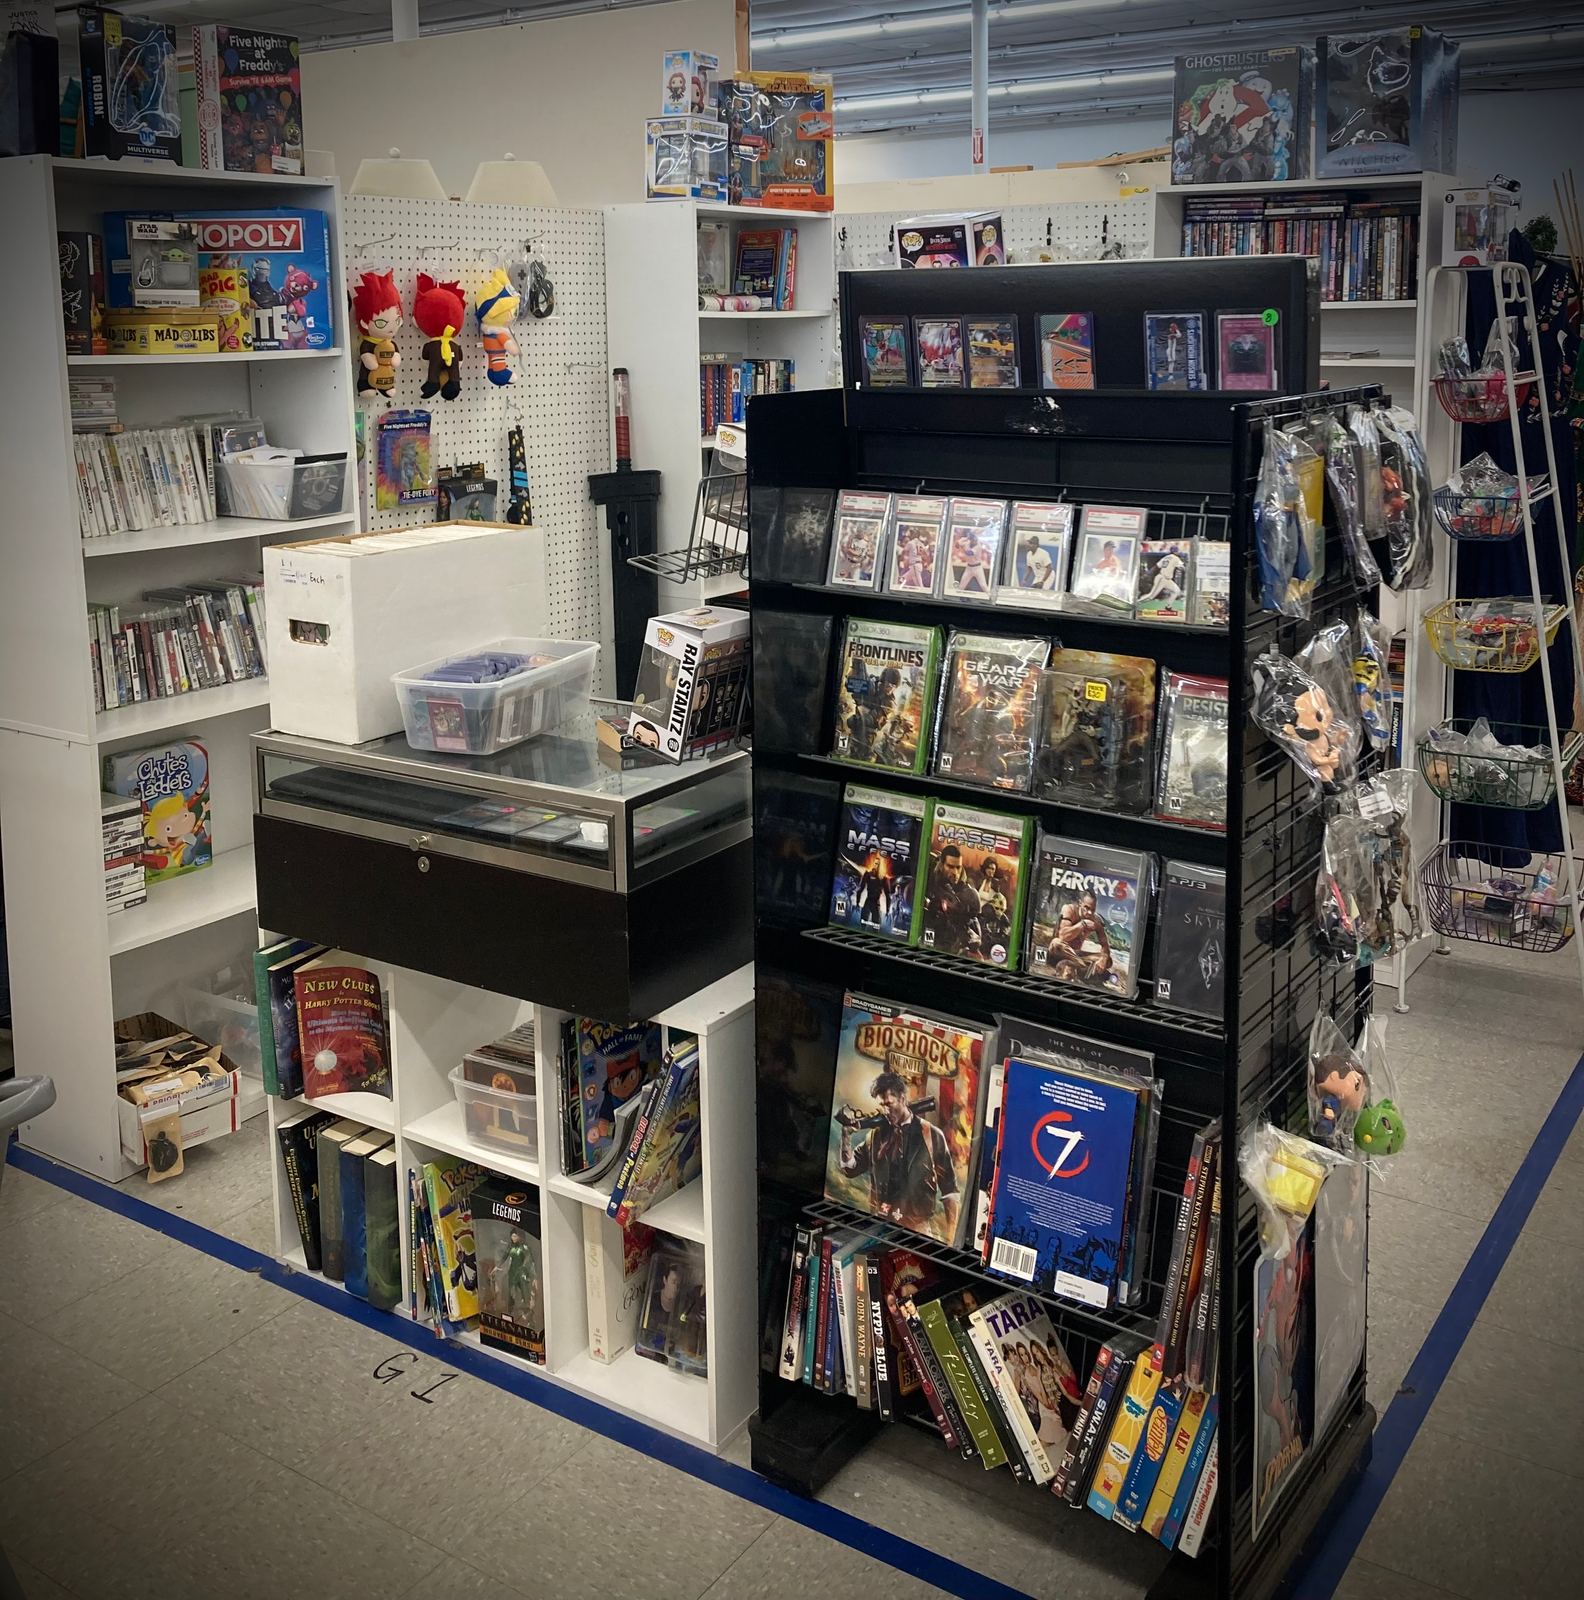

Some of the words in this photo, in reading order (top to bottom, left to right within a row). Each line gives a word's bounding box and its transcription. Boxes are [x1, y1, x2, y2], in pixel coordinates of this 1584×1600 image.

[229, 36, 251, 47] Five
[253, 36, 288, 49] Nights
[254, 49, 266, 59] at
[239, 59, 284, 73] Freddy's
[92, 75, 105, 116] ROBIN
[139, 130, 157, 144] DC
[127, 145, 169, 156] MULTIVERSE
[209, 276, 235, 296] PIG
[154, 328, 180, 341] MAD
[192, 329, 215, 341] LIBS
[82, 478, 93, 514] collection
[466, 483, 484, 492] LEGENDS
[681, 643, 698, 676] RAY
[848, 641, 924, 667] FRONTLINES
[963, 660, 1030, 678] GEARS
[979, 672, 1023, 689] WAR
[669, 677, 692, 737] STANTZ
[138, 752, 188, 781] Chutes
[941, 756, 952, 768] M
[139, 770, 192, 802] Ladders
[1172, 798, 1180, 807] M
[849, 829, 910, 854] MASS
[938, 825, 996, 844] MASS
[995, 836, 1011, 850] 2
[847, 843, 910, 862] EFFECT
[1054, 855, 1079, 866] PS3
[1179, 878, 1207, 890] PS3
[837, 903, 846, 911] M
[925, 932, 934, 942] M
[1037, 950, 1046, 962] M
[304, 980, 338, 994] NEW
[342, 978, 375, 994] CLUES
[1160, 983, 1169, 994] M
[305, 999, 332, 1010] HARRY
[333, 997, 362, 1006] POTTER
[851, 998, 892, 1013] BRADYGAMES
[602, 1039, 619, 1056] HALL
[624, 1034, 643, 1042] FAME
[864, 1026, 950, 1070] BIOSHOCK
[1049, 1039, 1064, 1048] THE
[1070, 1045, 1086, 1053] ART
[889, 1052, 924, 1074] INFINITE
[637, 1116, 649, 1134] BIG
[630, 1133, 644, 1153] BOOK
[1195, 1166, 1209, 1200] STEPHEN
[492, 1202, 522, 1223] LEGENDS
[1191, 1201, 1203, 1227] KING'S
[1185, 1240, 1195, 1256] DARK
[856, 1265, 864, 1274] 20
[1203, 1249, 1215, 1277] ENNIS
[857, 1297, 865, 1322] JOHN
[1177, 1293, 1186, 1310] LONG
[871, 1301, 883, 1336] NYPD
[986, 1296, 1044, 1338] TARA
[1174, 1311, 1182, 1328] ROAD
[1196, 1294, 1210, 1331] DILLON
[857, 1324, 865, 1358] WAYNE
[1170, 1329, 1178, 1347] HOME
[875, 1347, 887, 1381] BLUE
[914, 1329, 927, 1352] LAW
[925, 1361, 949, 1401] ORDER
[984, 1339, 1003, 1375] TARA
[1072, 1409, 1089, 1440] DYNASTY
[1085, 1398, 1107, 1445] S.W.A.T.
[1147, 1406, 1167, 1461] Seinfeld
[1175, 1427, 1190, 1455] ALF
